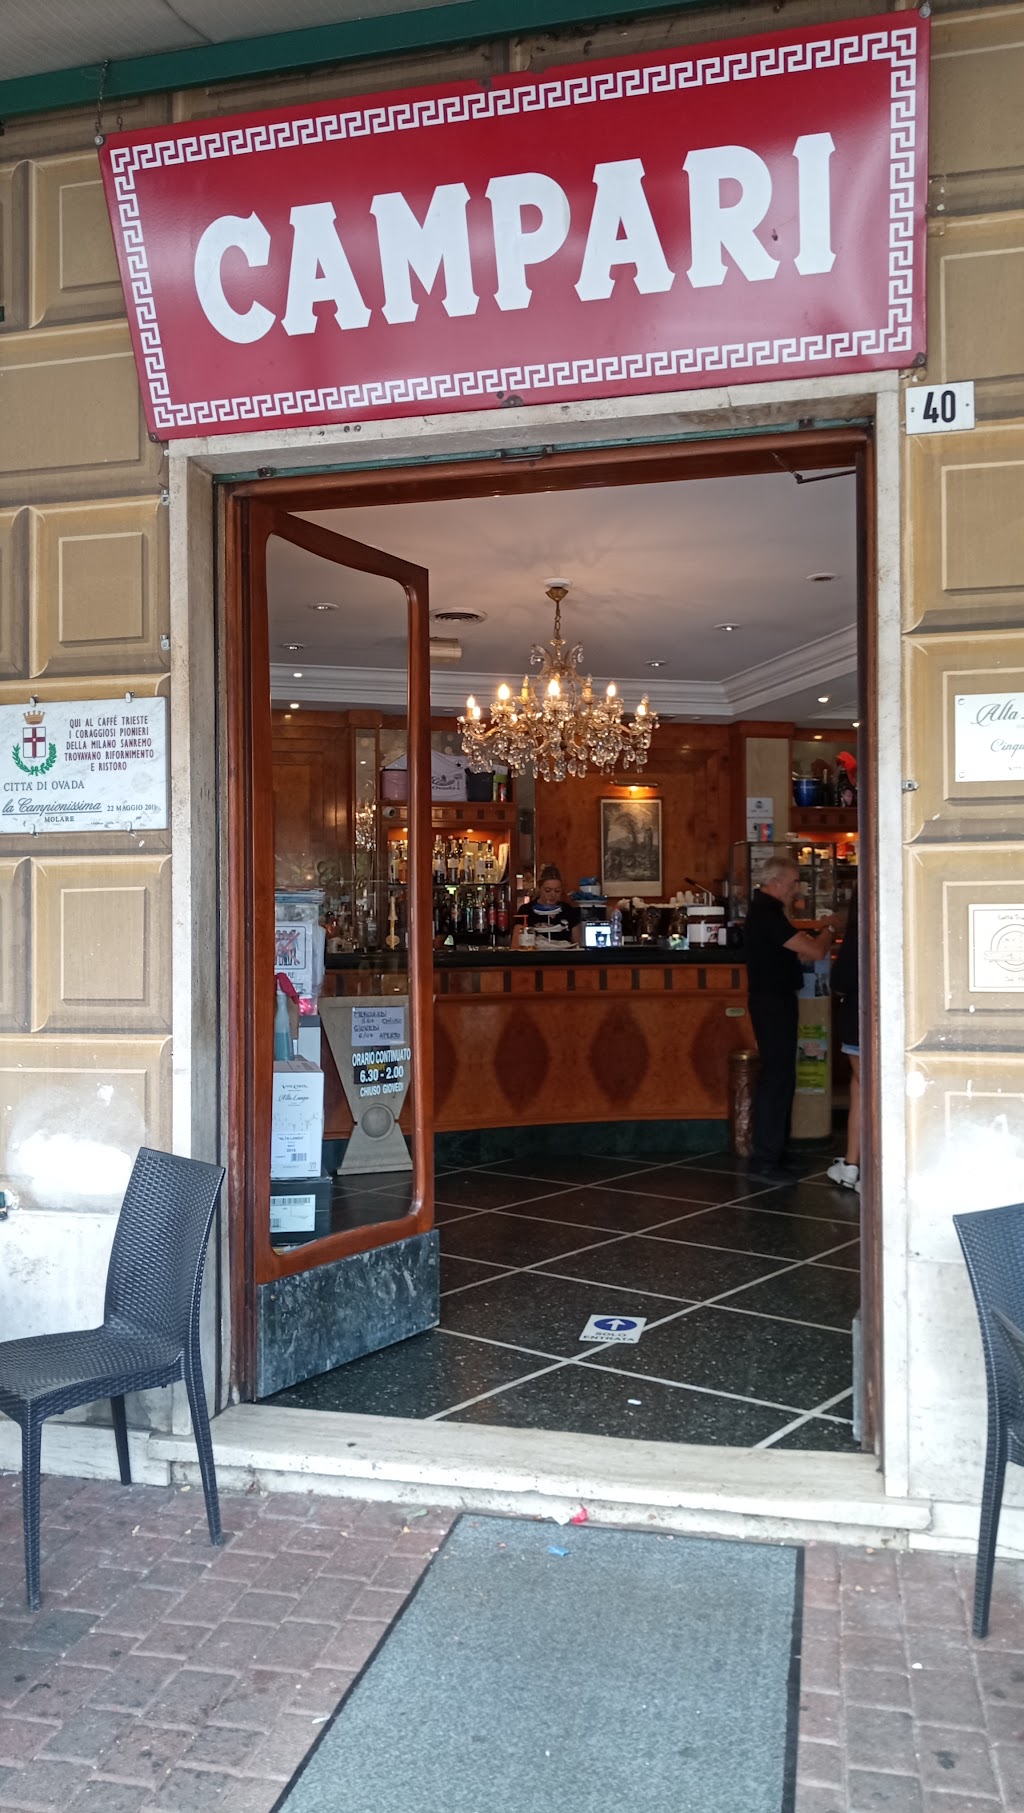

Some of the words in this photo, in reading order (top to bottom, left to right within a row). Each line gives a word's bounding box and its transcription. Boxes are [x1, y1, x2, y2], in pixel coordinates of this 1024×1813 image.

[194, 132, 837, 344] CAMPARI
[923, 390, 956, 423] 40
[970, 698, 1018, 727] Alta
[69, 718, 81, 729] QUI
[85, 718, 93, 727] AL
[122, 715, 148, 726] TRIESTE
[69, 730, 71, 739] I
[75, 728, 116, 739] CORAGGIOSI
[120, 727, 149, 737] PIONIERI
[66, 740, 87, 750] DELLA
[91, 739, 116, 749] MILANO
[120, 738, 152, 748] SANREMO
[64, 751, 101, 761] TROVAVANO
[105, 749, 154, 760] RIFORNIMENTO
[91, 762, 95, 771] E
[98, 761, 127, 771] RISTORO
[36, 781, 47, 791] DI
[51, 780, 85, 790] OVADA
[2, 799, 15, 813] la
[17, 797, 101, 816] Campionissima
[116, 804, 143, 812] MAGGIO
[352, 1051, 375, 1067] ORARIO
[375, 1047, 411, 1064] CONTINUATO
[360, 1069, 379, 1083] 6.30
[386, 1066, 404, 1080] 2.00
[360, 1085, 381, 1097] CHIUSO
